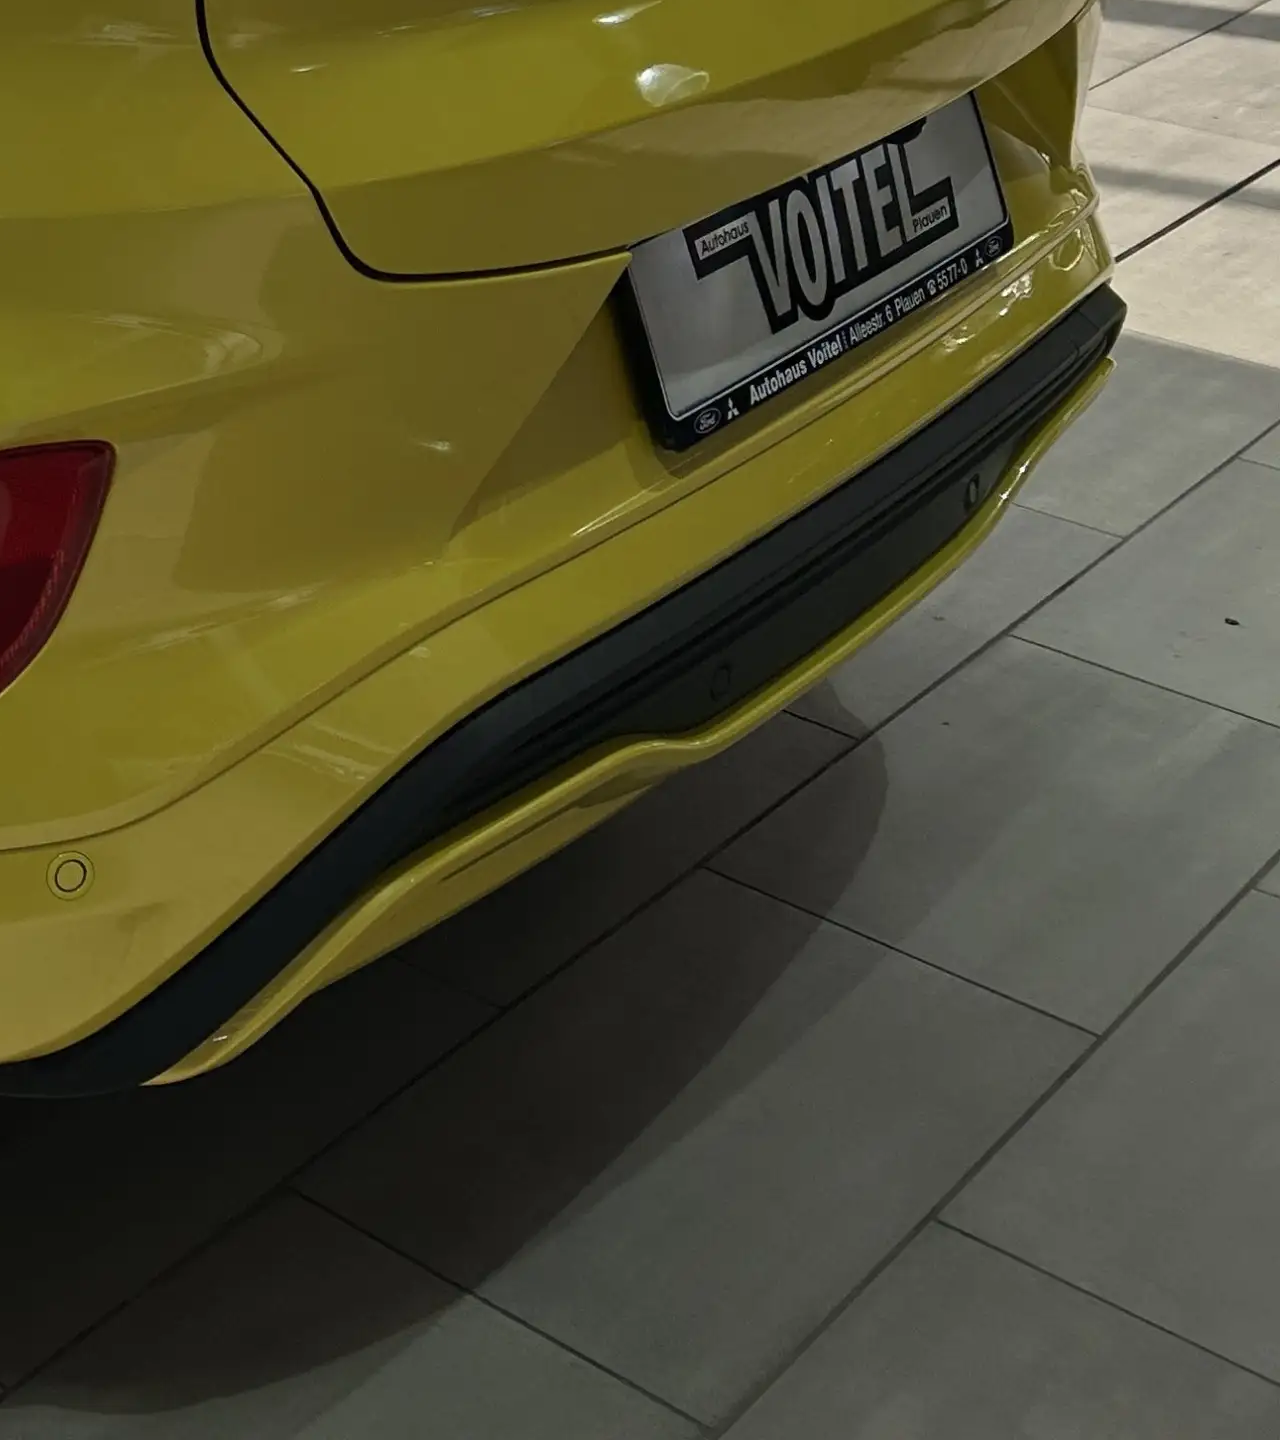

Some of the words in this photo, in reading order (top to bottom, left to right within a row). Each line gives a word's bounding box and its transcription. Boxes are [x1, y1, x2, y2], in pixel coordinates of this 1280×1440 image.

[700, 220, 750, 257] Autohaus
[748, 142, 940, 317] VOITEL
[912, 204, 949, 234] Plauen
[749, 358, 808, 406] Autohaus
[807, 334, 844, 368] Voitel
[849, 315, 886, 345] Alleestr.
[886, 304, 894, 323] 6
[894, 287, 925, 317] Plauen
